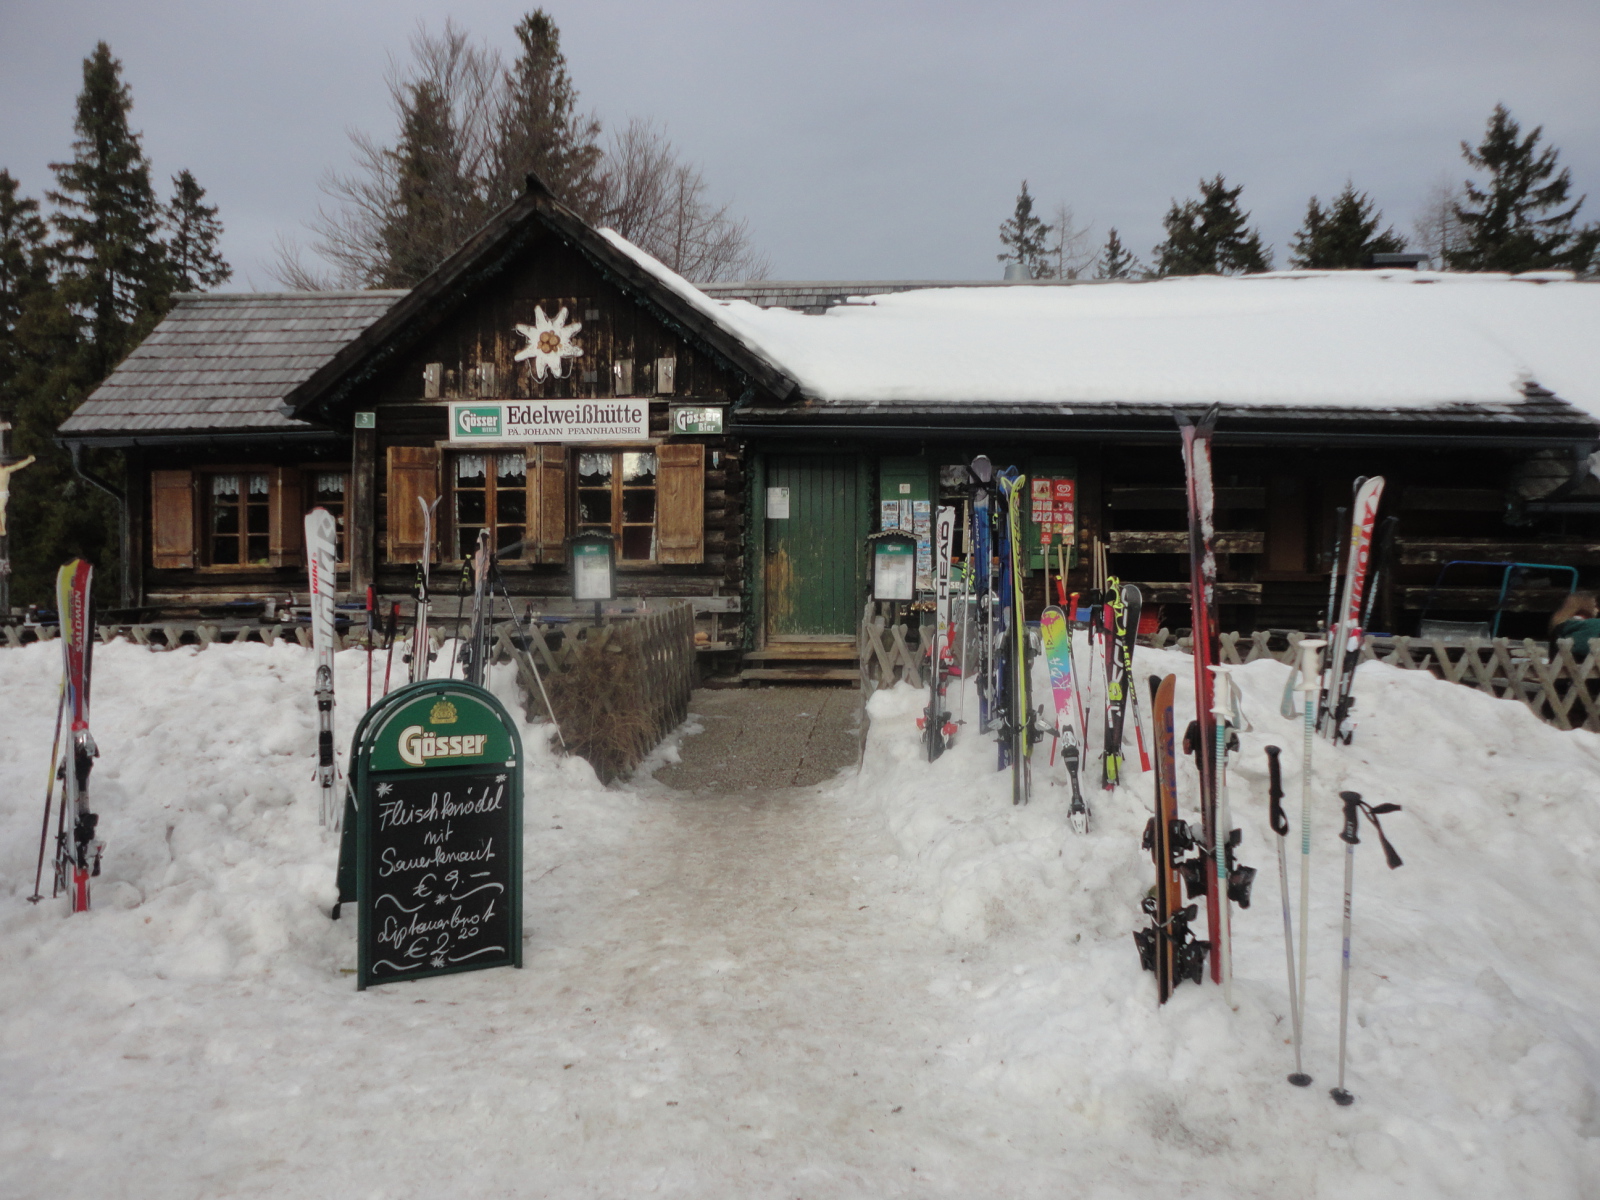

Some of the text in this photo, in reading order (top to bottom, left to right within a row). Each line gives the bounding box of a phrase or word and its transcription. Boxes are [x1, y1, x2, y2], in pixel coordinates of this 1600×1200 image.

[459, 409, 499, 433] Gösser
[507, 404, 642, 425] Edelweißhütte
[676, 410, 721, 431] Gösser
[523, 427, 564, 436] JOHANN
[568, 426, 642, 436] PFANNHAUSER
[698, 422, 716, 432] Bier
[939, 521, 950, 600] HEAD
[74, 590, 84, 654] SALOMON
[398, 724, 488, 766] Gösser
[424, 820, 454, 846] mit
[1346, 820, 1355, 838] LEKI
[412, 873, 438, 899] €
[1343, 891, 1352, 920] LEKI
[403, 936, 430, 959] €
